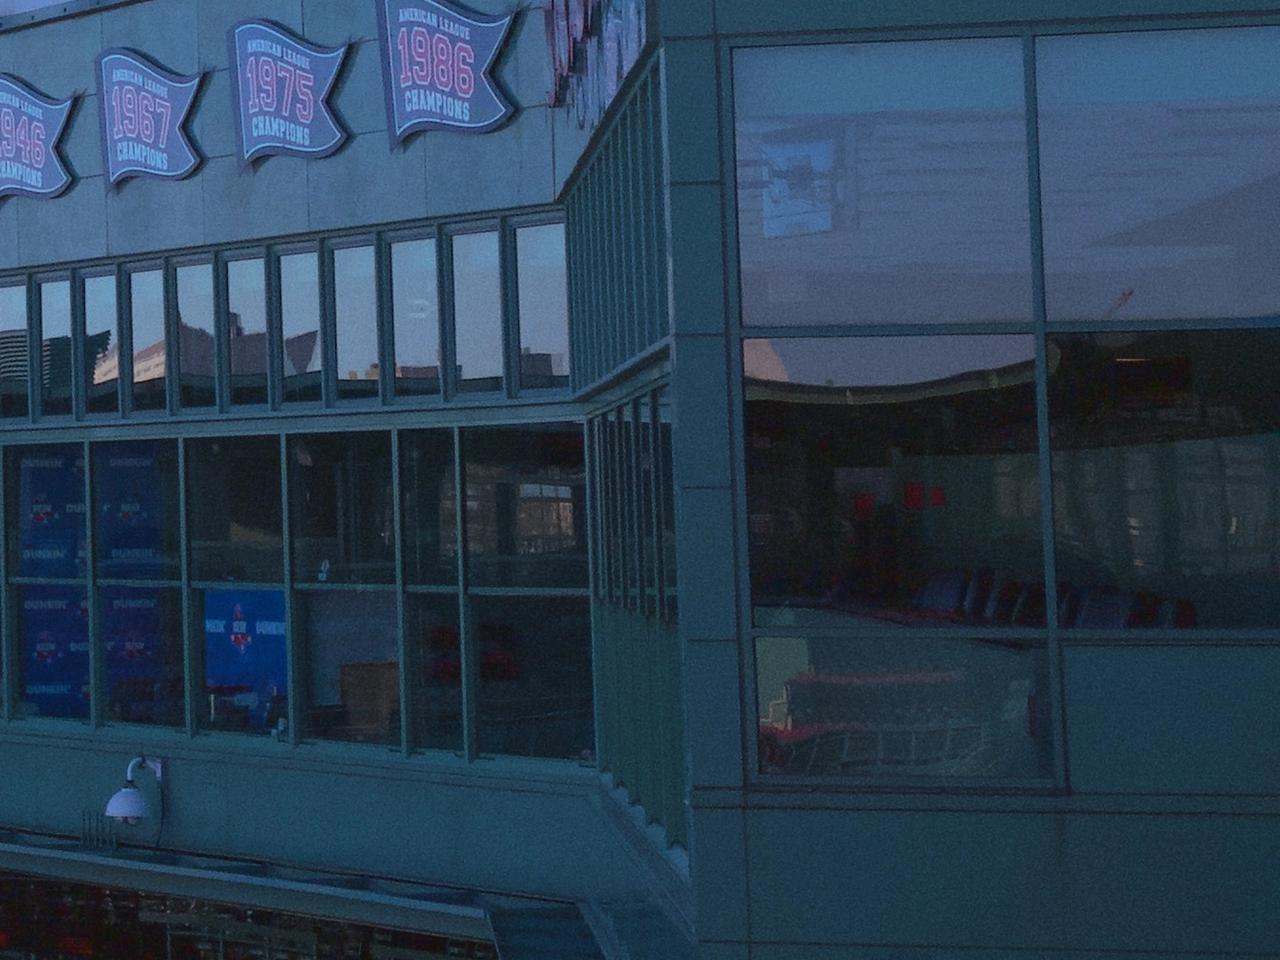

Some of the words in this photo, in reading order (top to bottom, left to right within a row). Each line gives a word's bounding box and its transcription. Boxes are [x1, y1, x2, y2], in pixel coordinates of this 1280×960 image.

[399, 7, 438, 28] AMERICAN
[439, 16, 471, 40] LEAGUE
[247, 40, 282, 57] AMERICAN
[397, 26, 475, 98] 1986
[246, 56, 314, 124] 1975
[404, 89, 470, 121] CHAMPIONS
[112, 86, 171, 148] 1967
[251, 116, 310, 146] CHAMPIONS
[117, 141, 168, 170] CHAMPIONS
